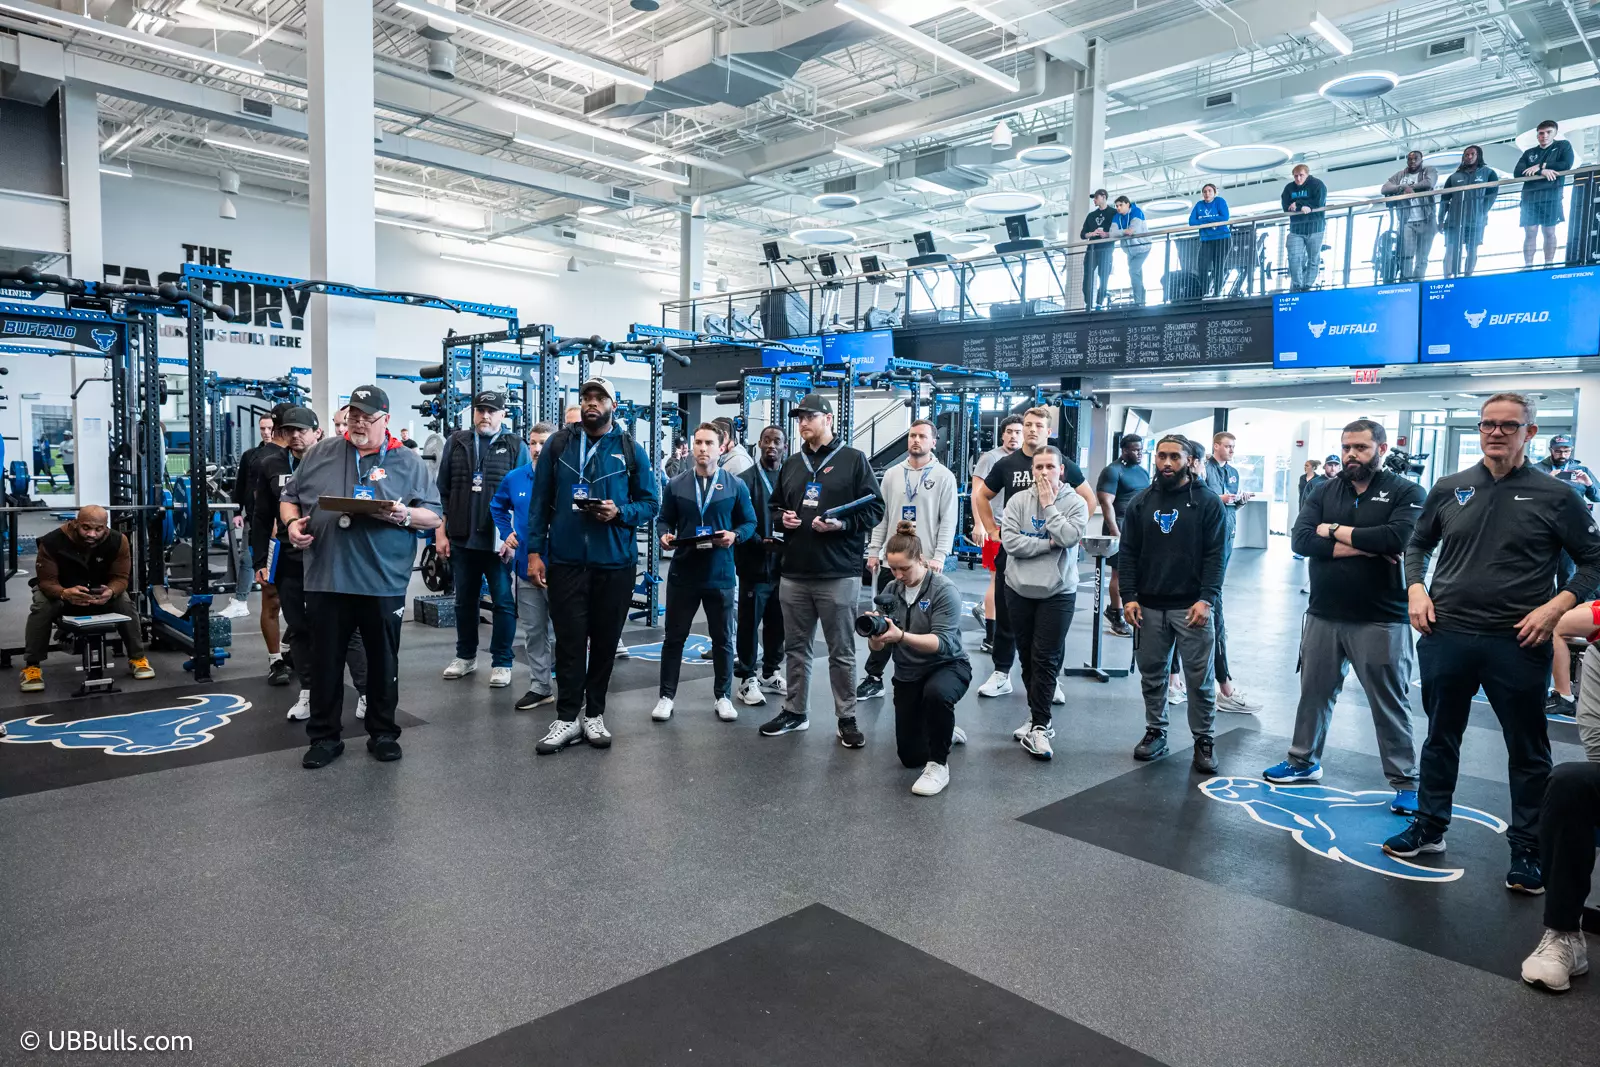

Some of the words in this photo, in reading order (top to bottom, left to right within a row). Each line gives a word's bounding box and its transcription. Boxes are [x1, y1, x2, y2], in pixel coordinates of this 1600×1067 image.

[182, 244, 232, 269] THE
[1489, 311, 1549, 325] BUFFALO
[2, 321, 76, 338] BUFFALO
[1328, 323, 1377, 335] BUFFALO
[270, 335, 301, 348] HERE
[482, 364, 522, 376] BUFFALO
[1355, 370, 1379, 384] EXIT
